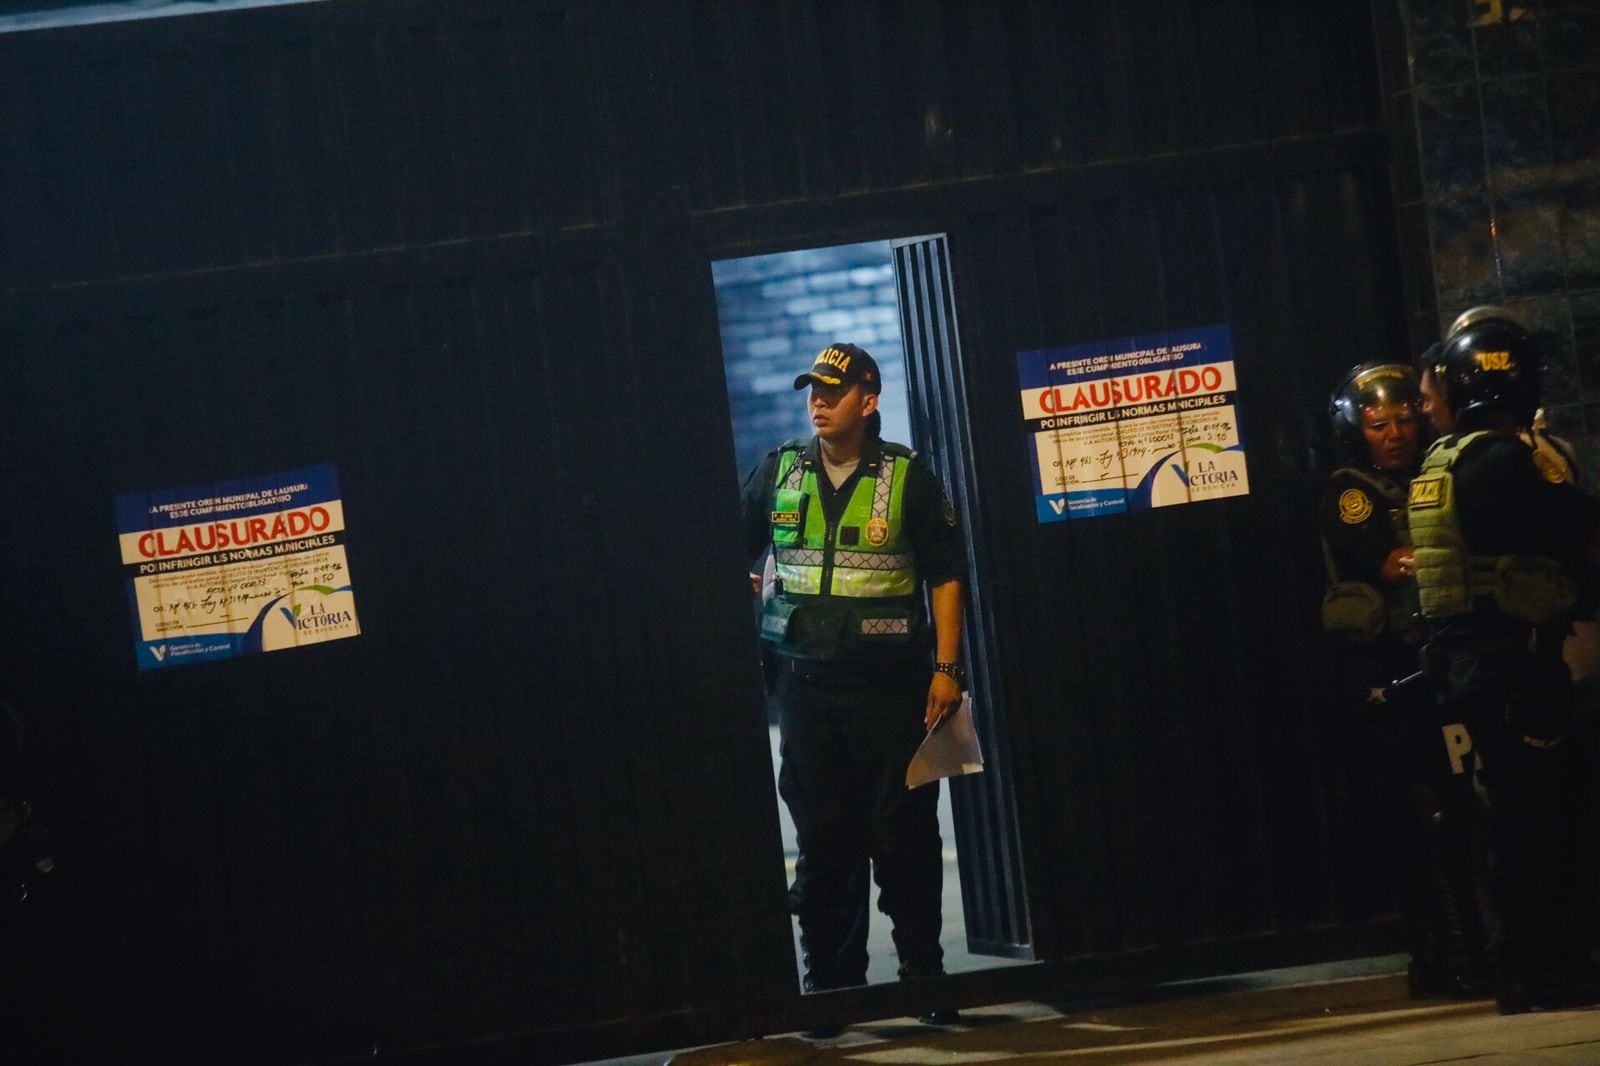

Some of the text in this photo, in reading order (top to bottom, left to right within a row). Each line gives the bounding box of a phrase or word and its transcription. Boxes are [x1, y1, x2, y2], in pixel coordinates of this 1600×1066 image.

[812, 347, 852, 373] LICIA
[1156, 346, 1168, 356] DE
[1172, 342, 1202, 354] AUSURA
[1039, 366, 1223, 414] CLAUSURADO
[1040, 394, 1226, 429] PO INFRINGIR LS NORMAS MNICIPALES
[1170, 460, 1239, 488] VCTORIA
[1198, 460, 1216, 473] LA
[261, 489, 273, 499] DE
[273, 483, 308, 496] CAUSUR
[1103, 497, 1125, 506] Control
[137, 506, 330, 559] CLAUSURADO
[140, 563, 157, 574] PO
[158, 555, 211, 572] INFRINGIR
[213, 553, 228, 564] LS
[229, 545, 273, 561] NORMAS
[279, 603, 352, 631] VICTORIA
[310, 601, 326, 616] LA
[208, 642, 231, 652] Control
